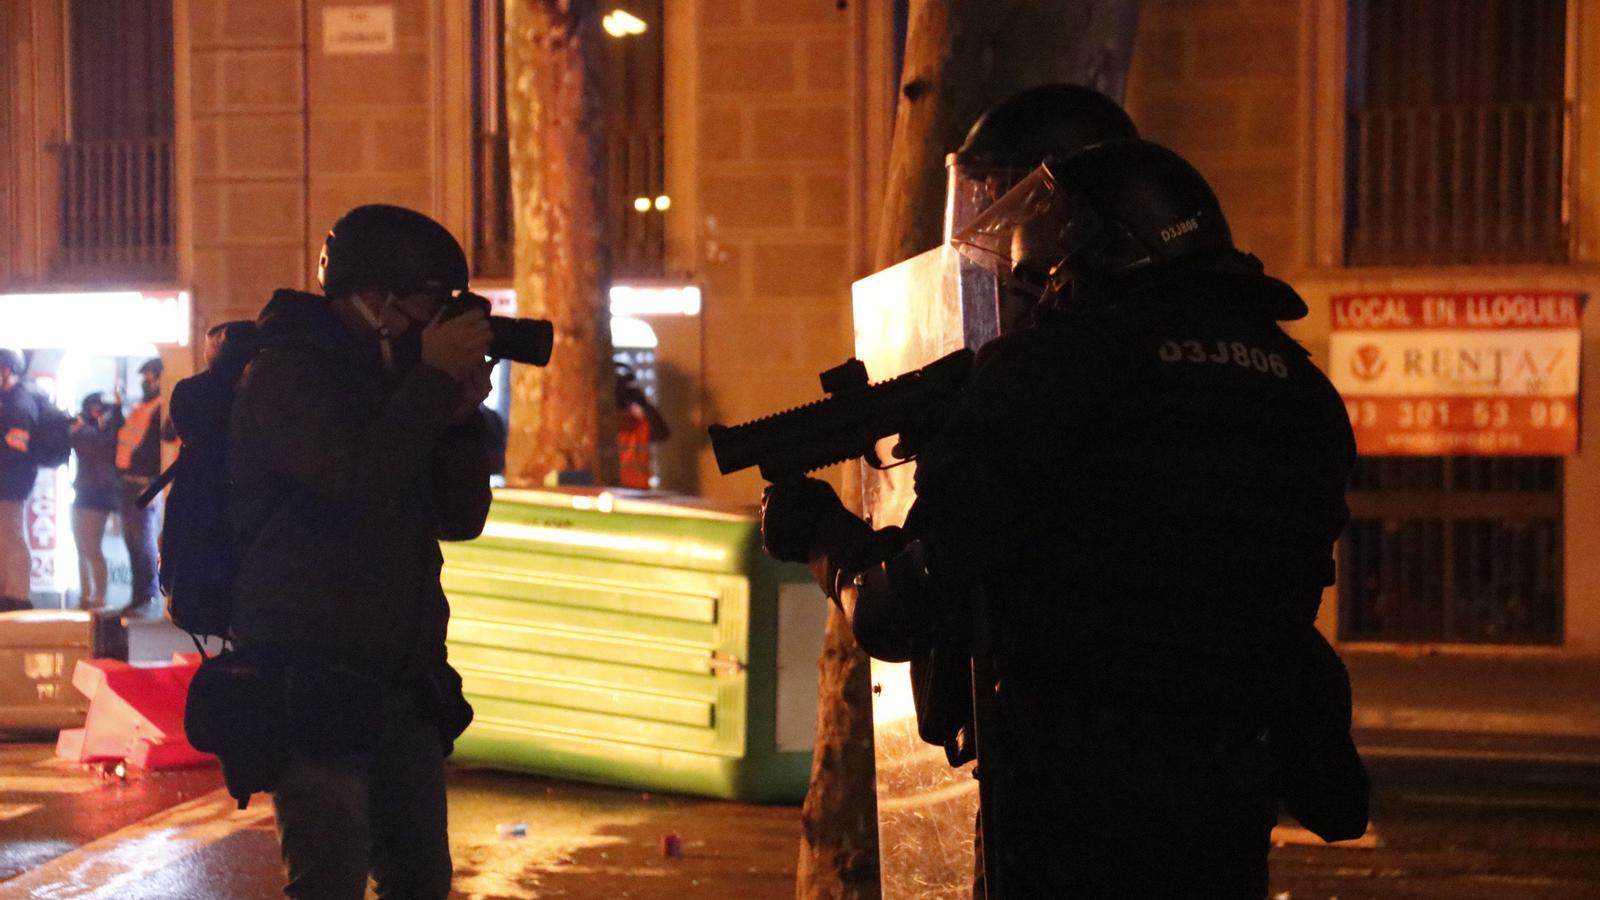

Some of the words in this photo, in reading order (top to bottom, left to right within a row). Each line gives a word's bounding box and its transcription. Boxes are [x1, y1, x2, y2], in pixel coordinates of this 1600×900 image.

[1335, 298, 1410, 325] LOCAL
[1422, 297, 1456, 324] EN
[1466, 296, 1577, 325] LLOGUER
[1159, 340, 1289, 379] D3J806
[1397, 400, 1450, 428] 301
[30, 557, 55, 578] 24
